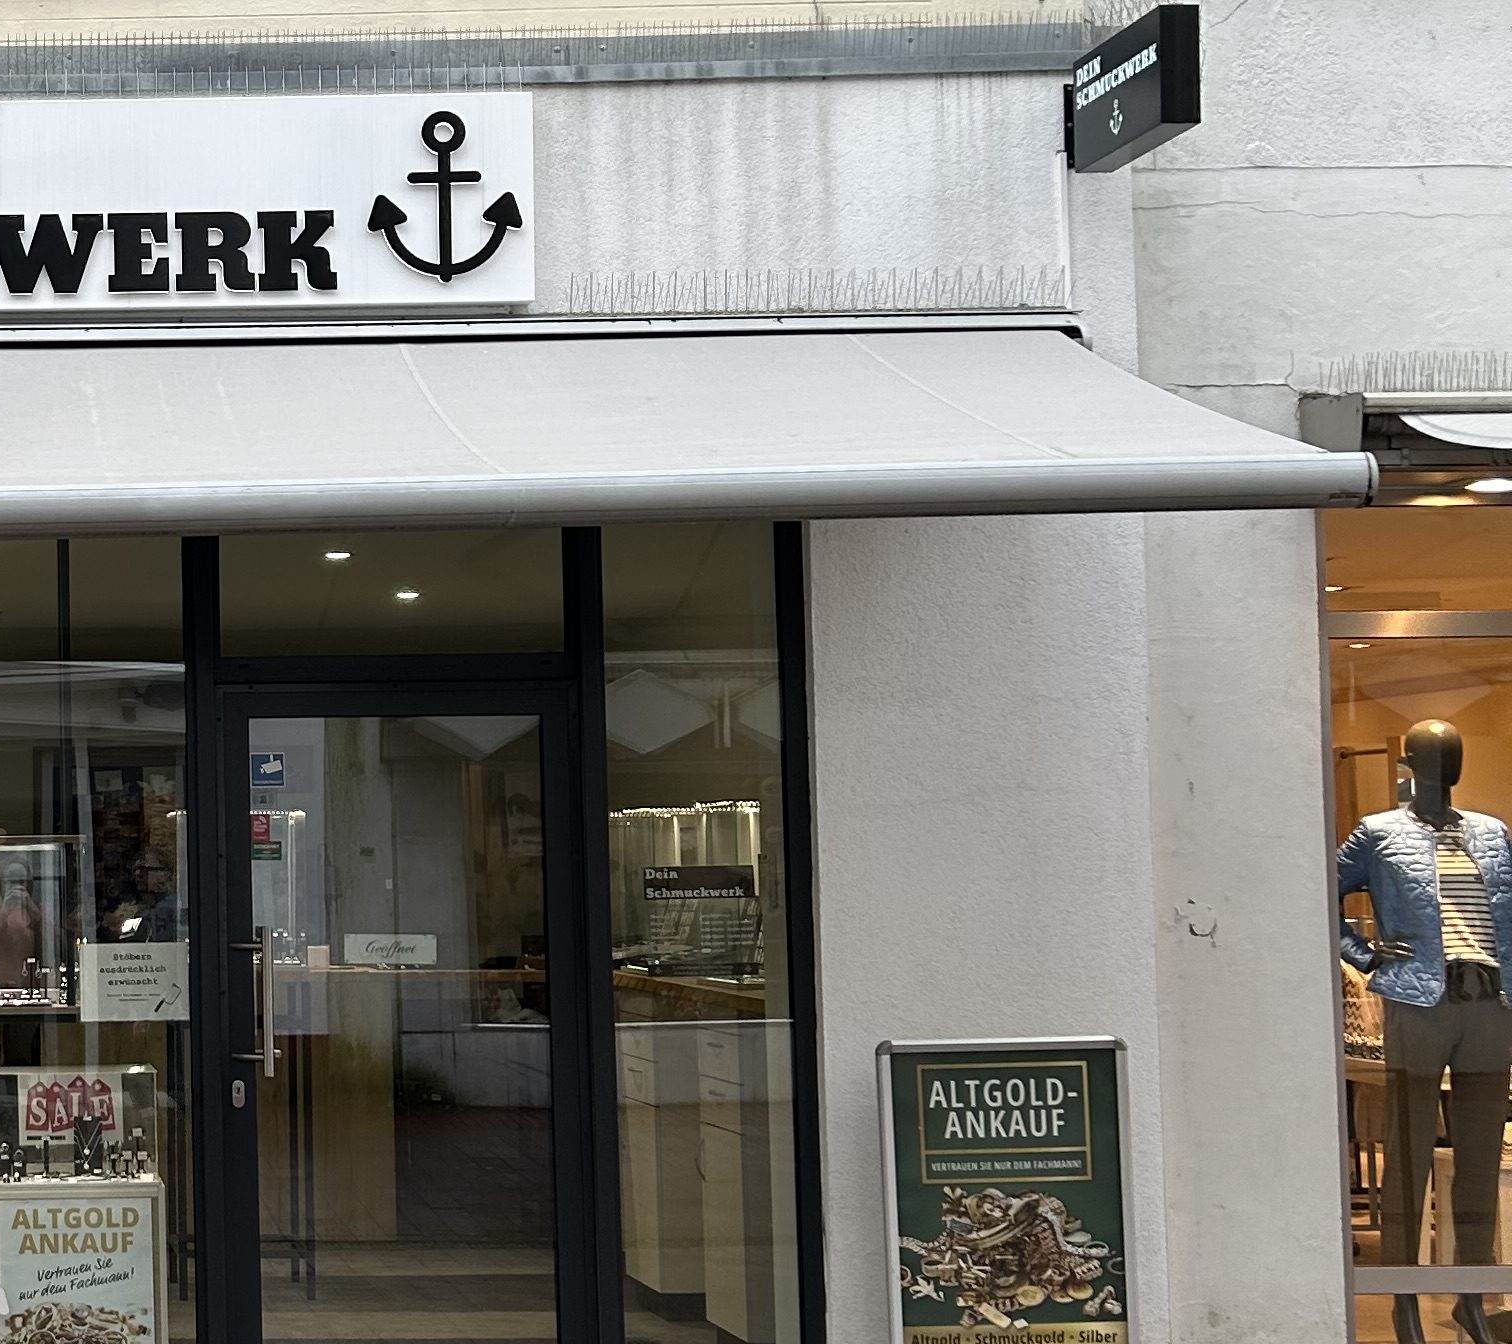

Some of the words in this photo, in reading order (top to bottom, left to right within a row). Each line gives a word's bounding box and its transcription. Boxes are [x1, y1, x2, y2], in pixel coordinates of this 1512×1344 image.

[1076, 56, 1101, 87] DEIN
[1076, 42, 1157, 110] SCHMUCKWERK
[645, 868, 679, 880] Dein
[645, 886, 745, 899] Schmuckwerk
[929, 1077, 1079, 1109] ALTGOLD-
[29, 1092, 114, 1127] SALE
[944, 1108, 1066, 1140] ANKAUF
[11, 1207, 140, 1230] ALTGOLD
[18, 1232, 134, 1255] ANKAUF
[37, 1263, 92, 1282] Vertrauen
[94, 1256, 113, 1270] Sie
[19, 1288, 39, 1301] nur
[40, 1280, 66, 1297] dem
[69, 1267, 135, 1291] Fachmann!
[1078, 1330, 1118, 1343] Silber
